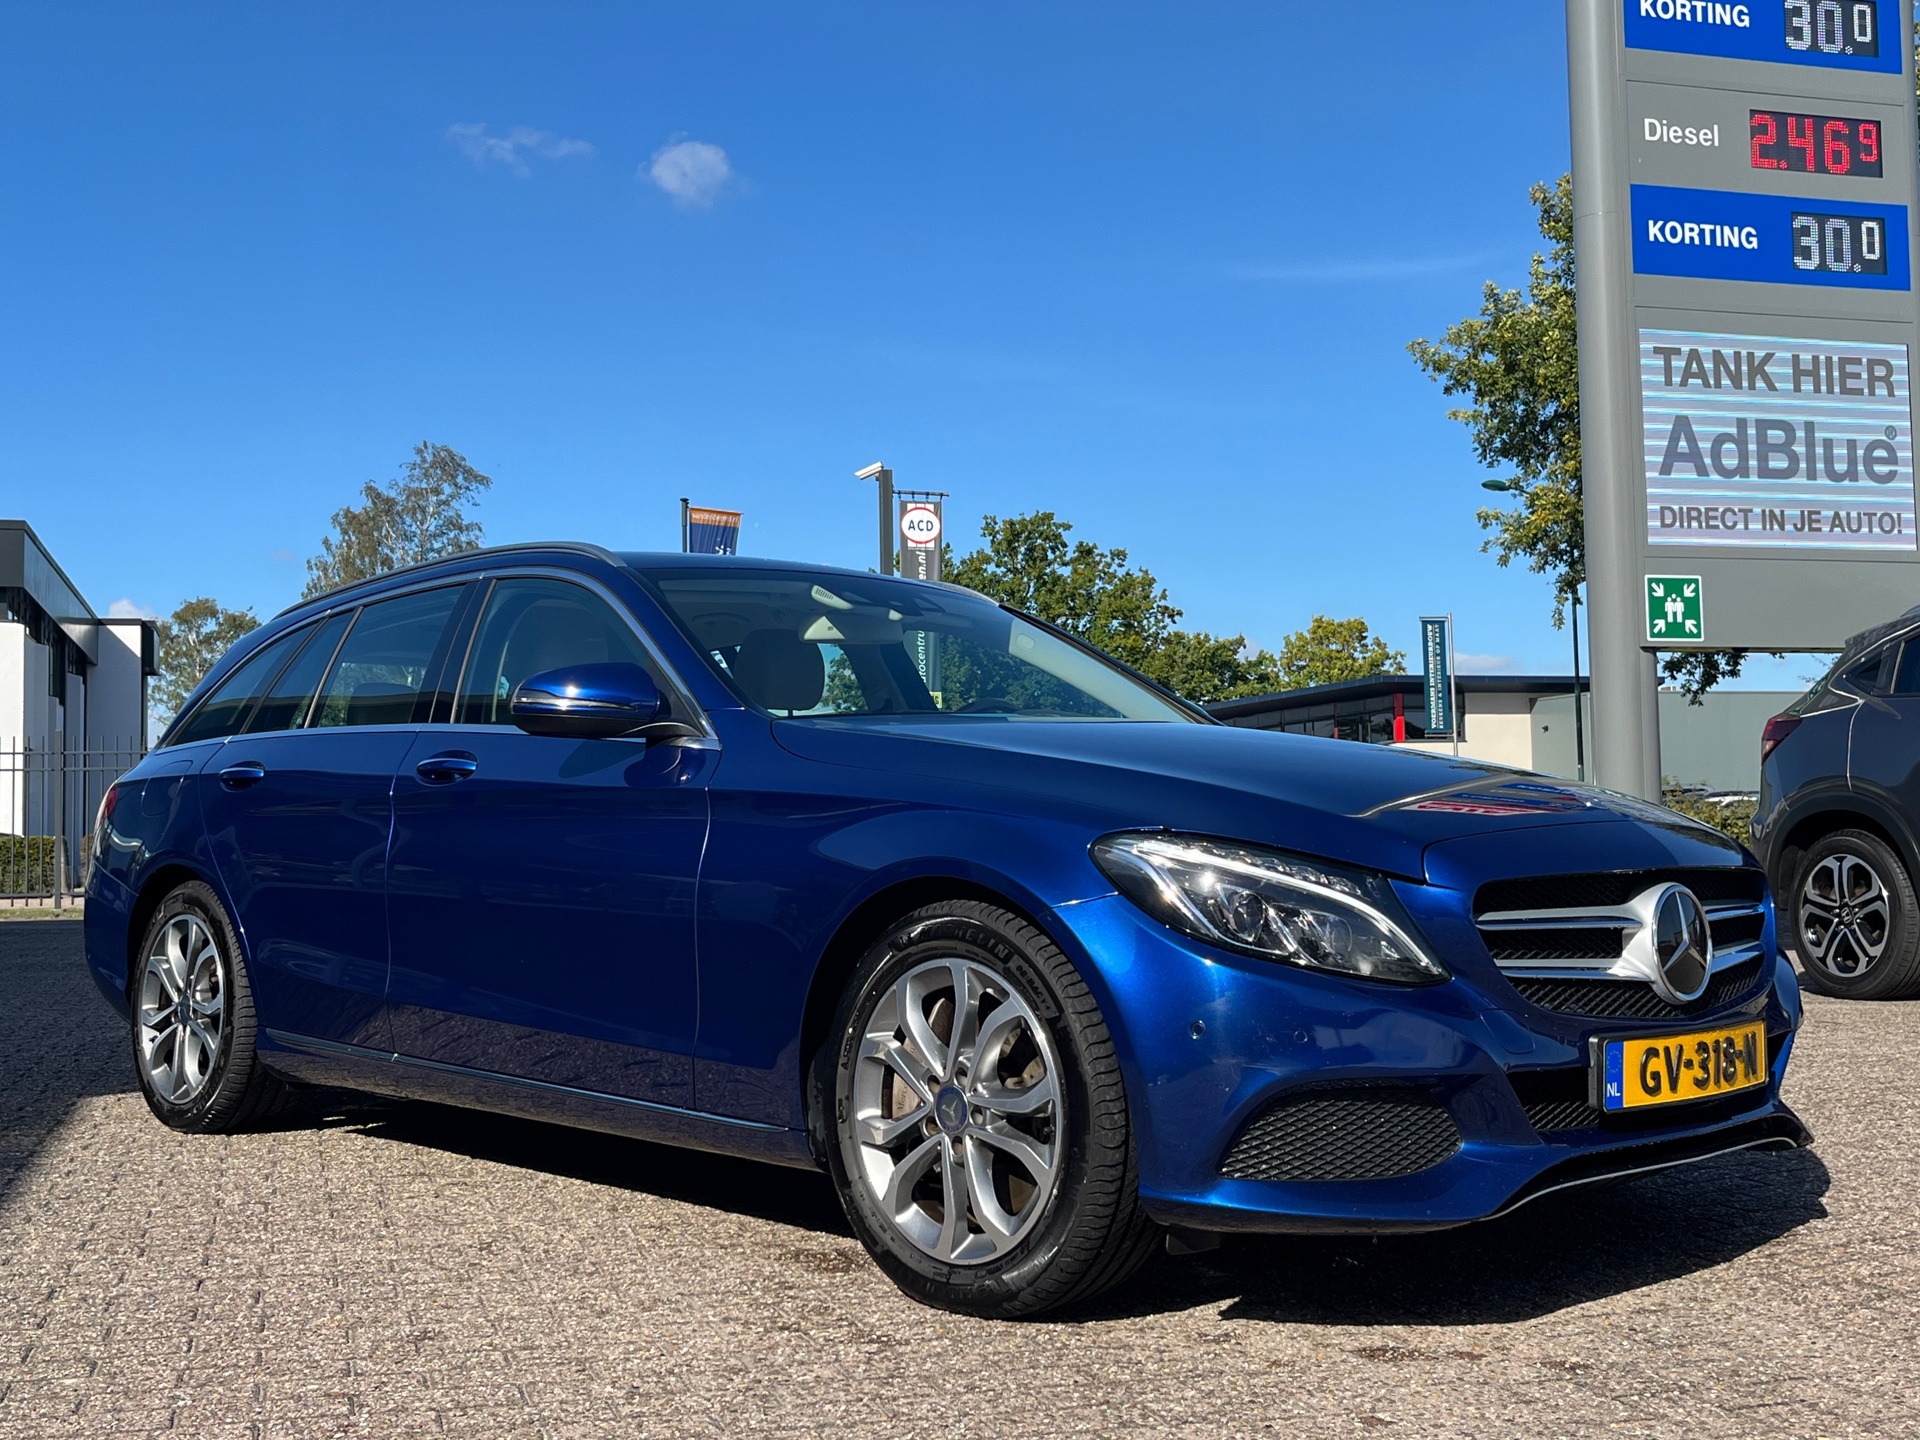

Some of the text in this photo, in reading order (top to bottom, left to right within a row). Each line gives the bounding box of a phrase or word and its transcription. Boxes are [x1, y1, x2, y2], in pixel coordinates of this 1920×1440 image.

[1640, 0, 1750, 28] KORTING
[1644, 118, 1719, 146] Diesel
[1648, 220, 1758, 250] KORTING
[1653, 346, 1895, 398] TANK HIER
[1659, 505, 1903, 535] DIRECT IN JE AUTO!
[1606, 1082, 1621, 1097] NL
